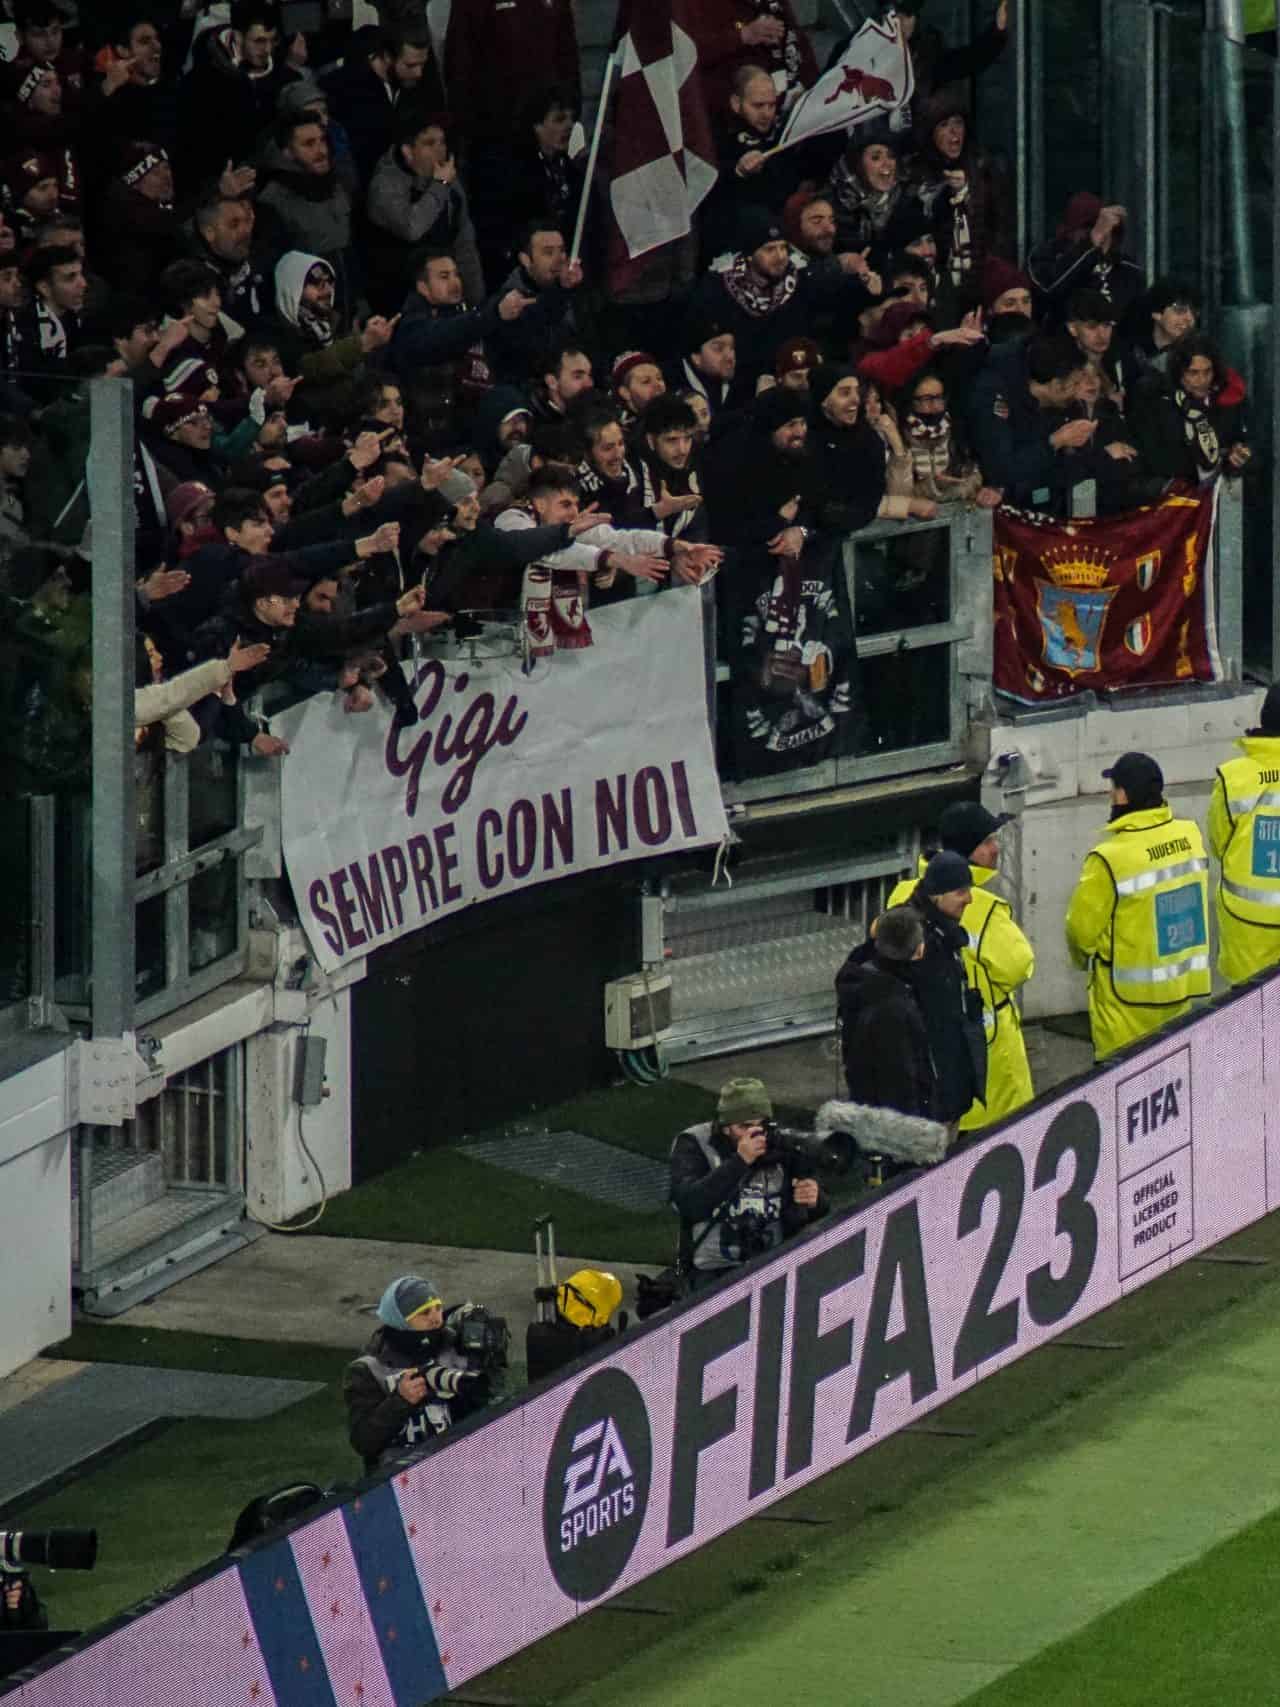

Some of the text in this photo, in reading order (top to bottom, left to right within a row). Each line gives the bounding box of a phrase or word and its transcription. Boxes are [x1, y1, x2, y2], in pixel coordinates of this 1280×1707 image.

[385, 659, 528, 817] Gigi
[308, 759, 698, 957] SEMPRE CON NOI
[1146, 836, 1192, 862] JUVENTUS
[1127, 1082, 1180, 1145] FIFA
[1132, 1170, 1177, 1207] OFFICIAL
[1132, 1190, 1179, 1228] LICENSED
[1132, 1212, 1178, 1249] PRODUCT
[665, 1100, 1101, 1550] FIFA 23
[561, 1416, 633, 1515] EA
[560, 1482, 635, 1553] SPORTS
